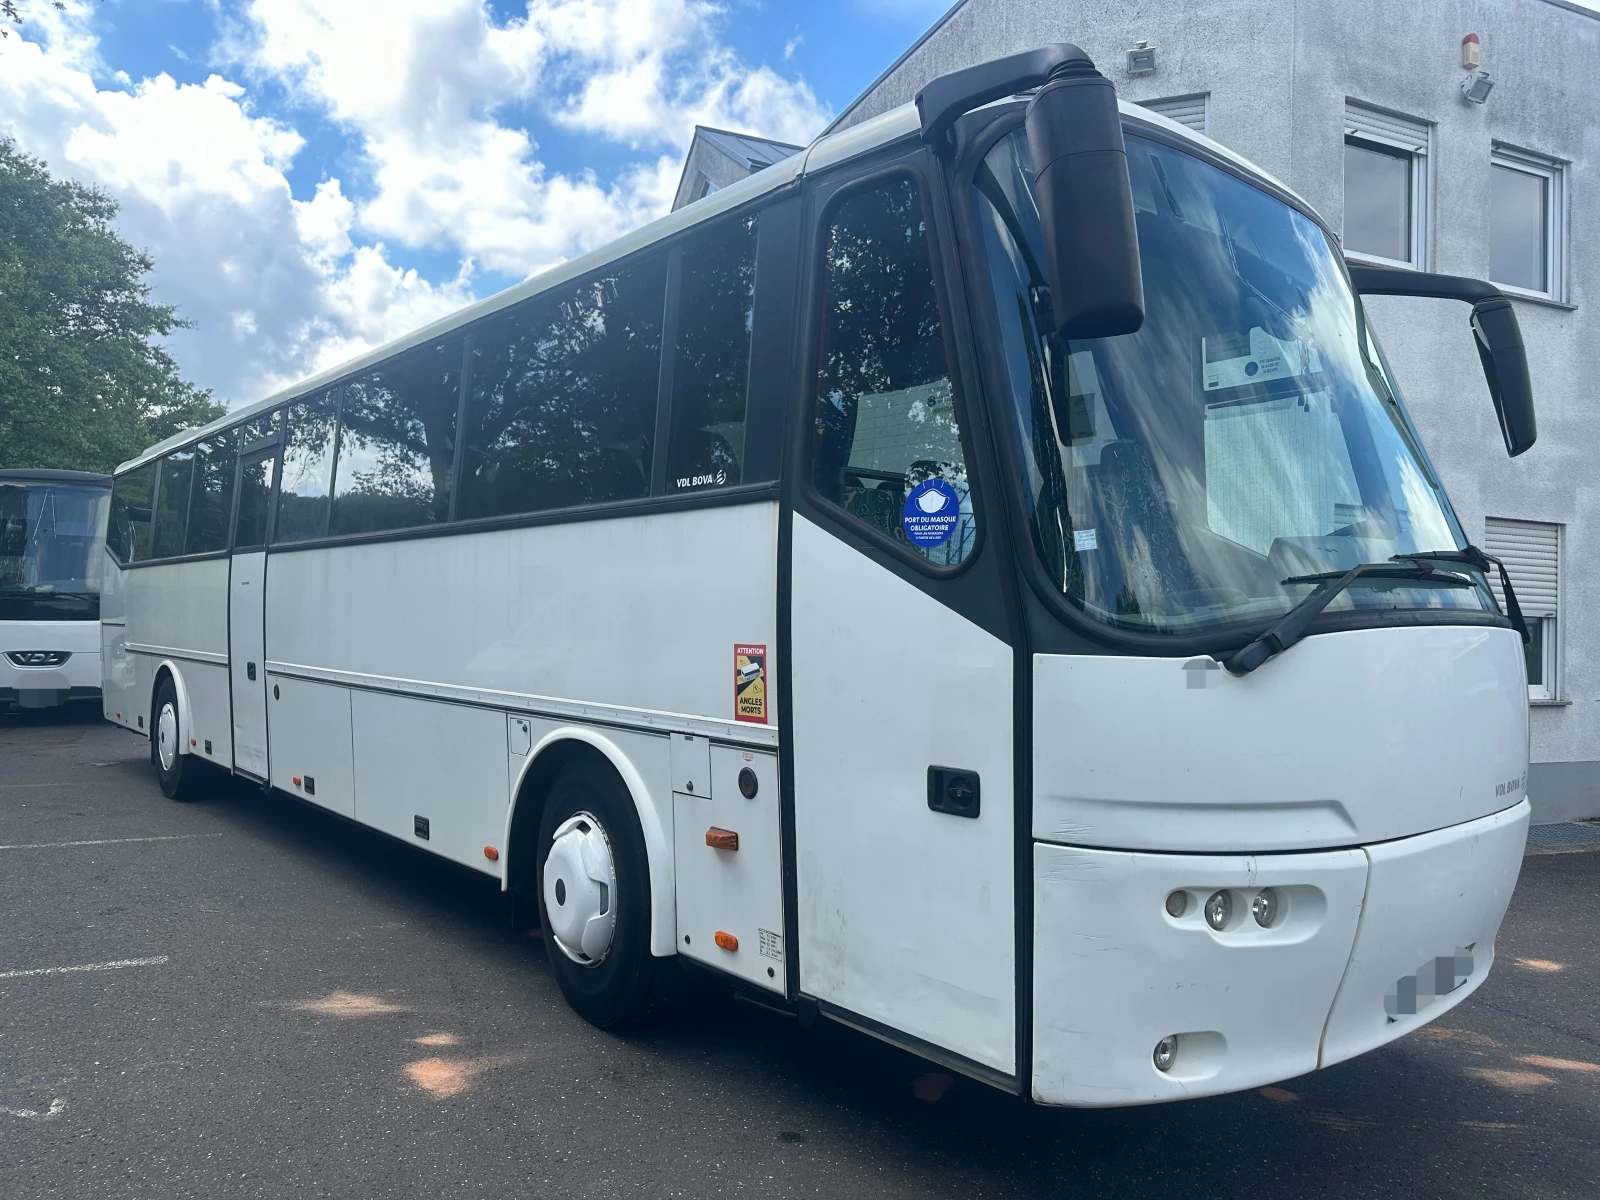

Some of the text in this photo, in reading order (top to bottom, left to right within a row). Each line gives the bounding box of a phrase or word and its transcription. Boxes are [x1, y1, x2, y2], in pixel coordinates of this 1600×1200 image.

[676, 474, 713, 488] VDL BOVA
[930, 515, 957, 524] MASQUE
[736, 647, 764, 655] ATTENTION
[14, 653, 59, 663] VDL
[739, 697, 763, 706] ANGLES
[740, 706, 762, 715] MORTS
